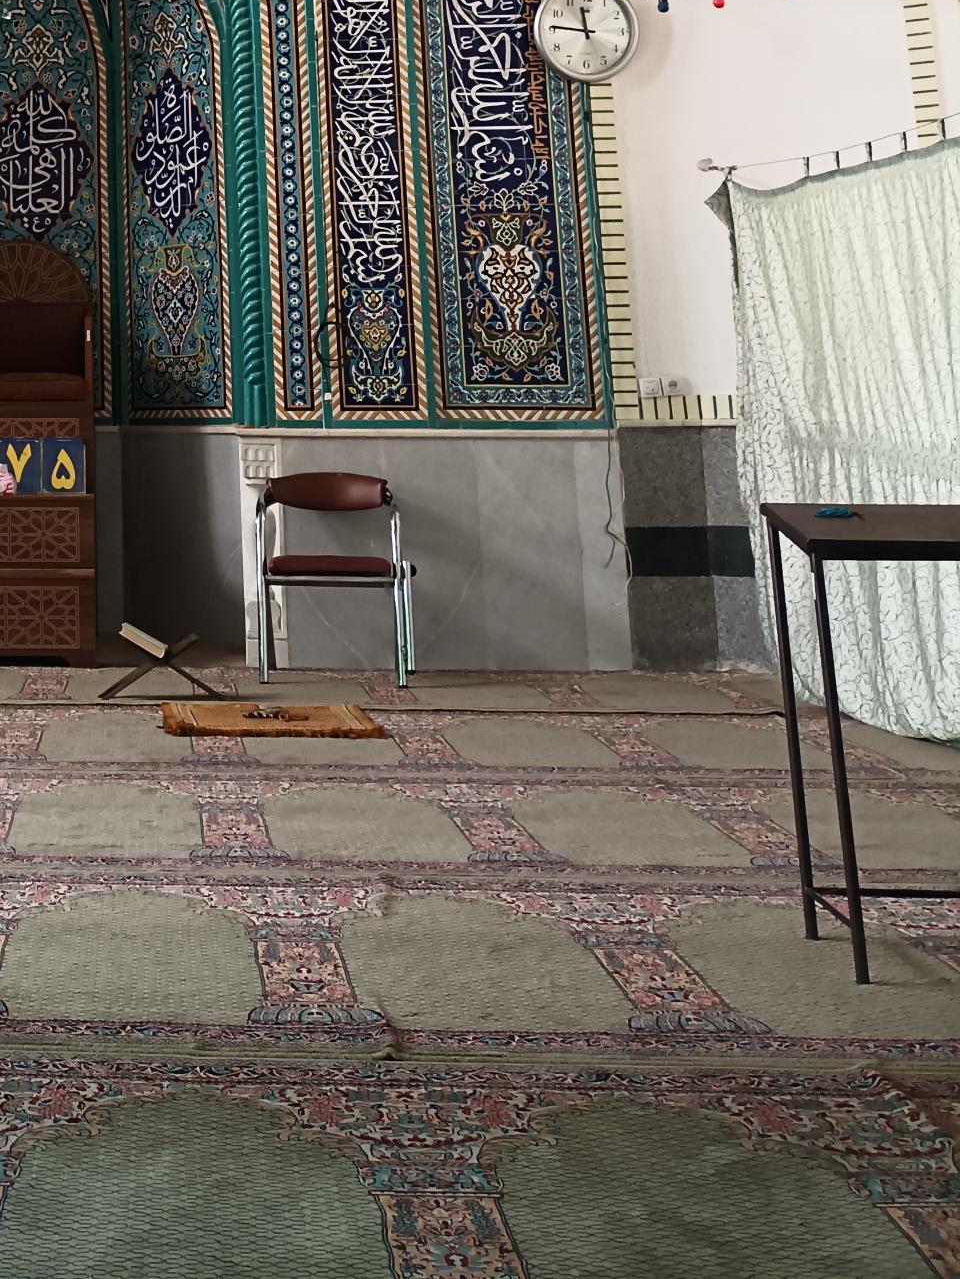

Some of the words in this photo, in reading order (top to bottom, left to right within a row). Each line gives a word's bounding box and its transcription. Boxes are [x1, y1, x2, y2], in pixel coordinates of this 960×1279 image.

[552, 9, 563, 18] 10
[614, 11, 619, 19] 2
[618, 27, 624, 36] 3
[612, 45, 618, 53] 4
[566, 55, 572, 64] 7
[600, 56, 607, 65] 5
[583, 60, 590, 69] 6
